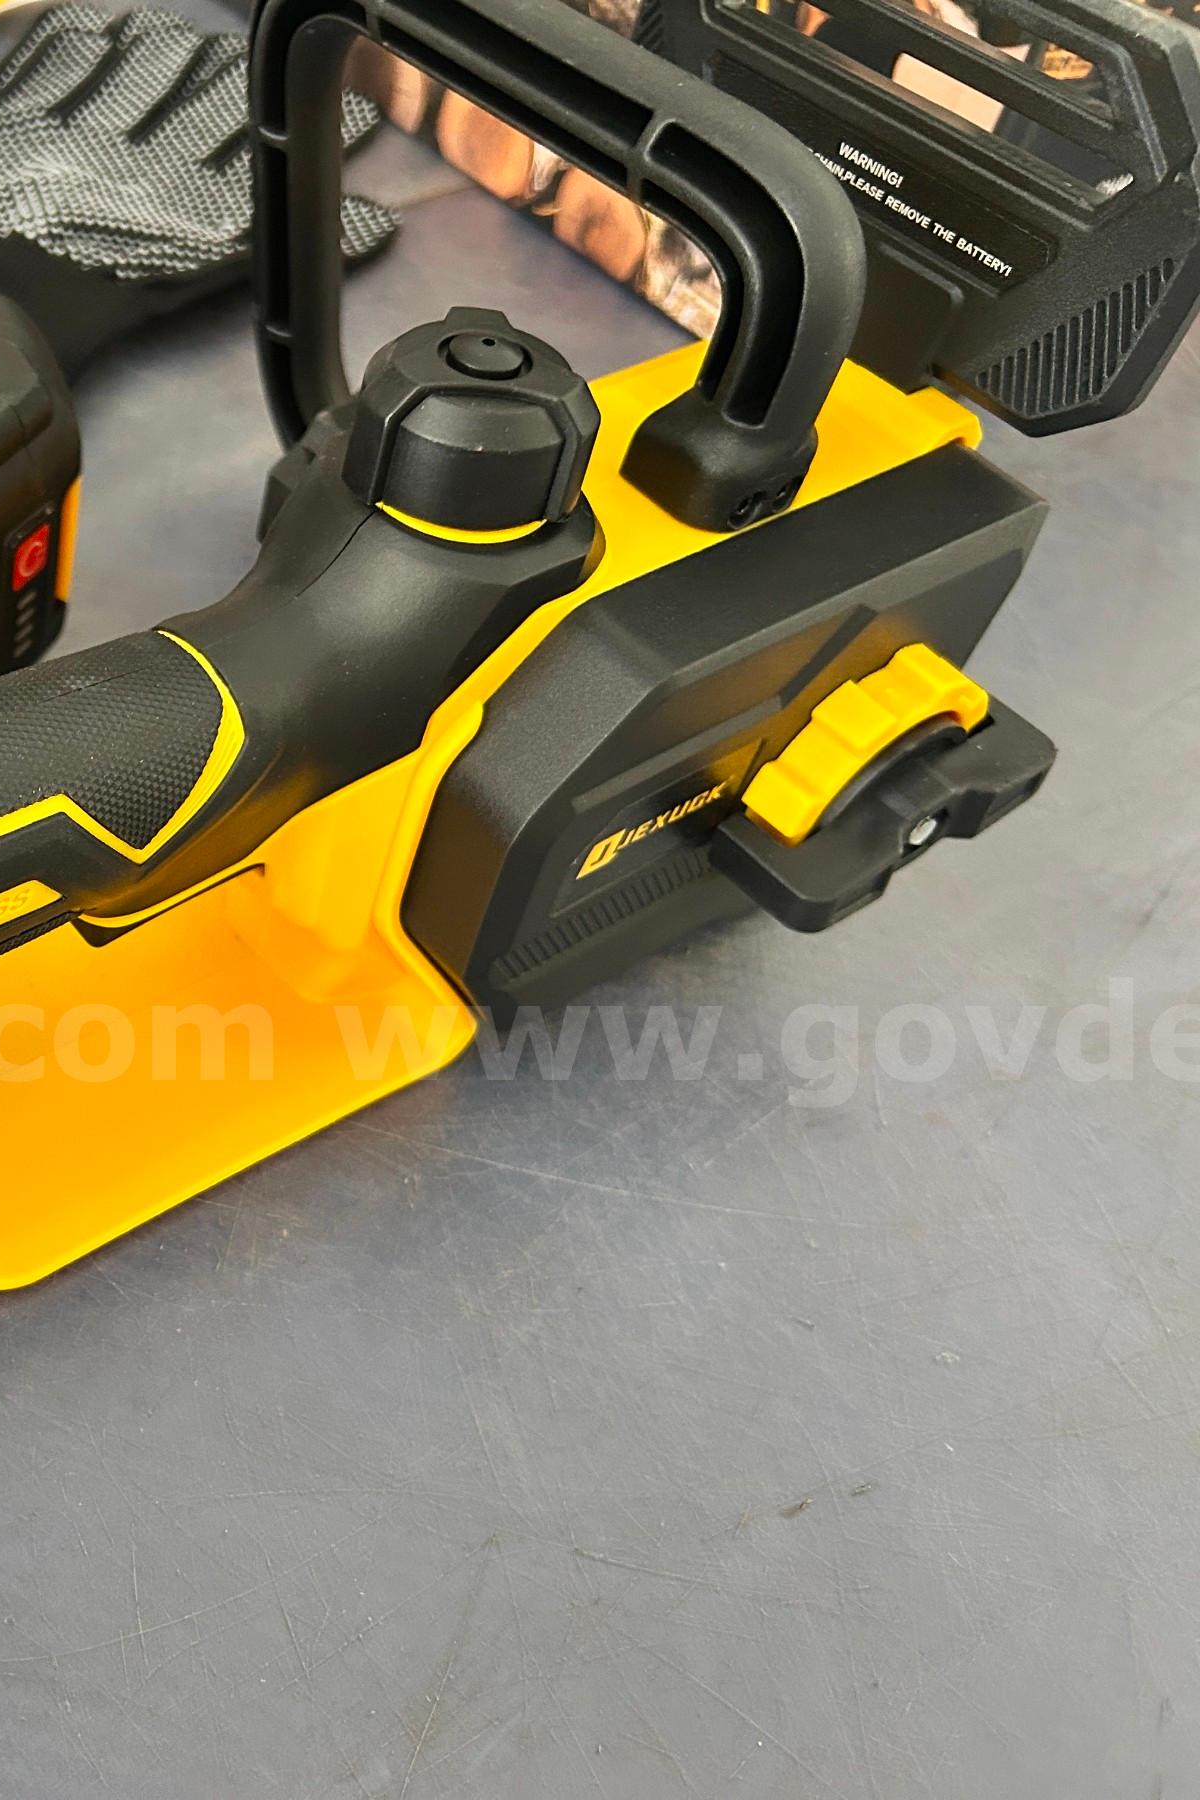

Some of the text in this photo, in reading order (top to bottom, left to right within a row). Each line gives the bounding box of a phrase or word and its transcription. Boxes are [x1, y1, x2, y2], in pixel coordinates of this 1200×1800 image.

[837, 141, 904, 188] WARNING!
[884, 195, 931, 229] REMOVE
[931, 222, 956, 244] THE
[956, 237, 1013, 277] BATTERY!
